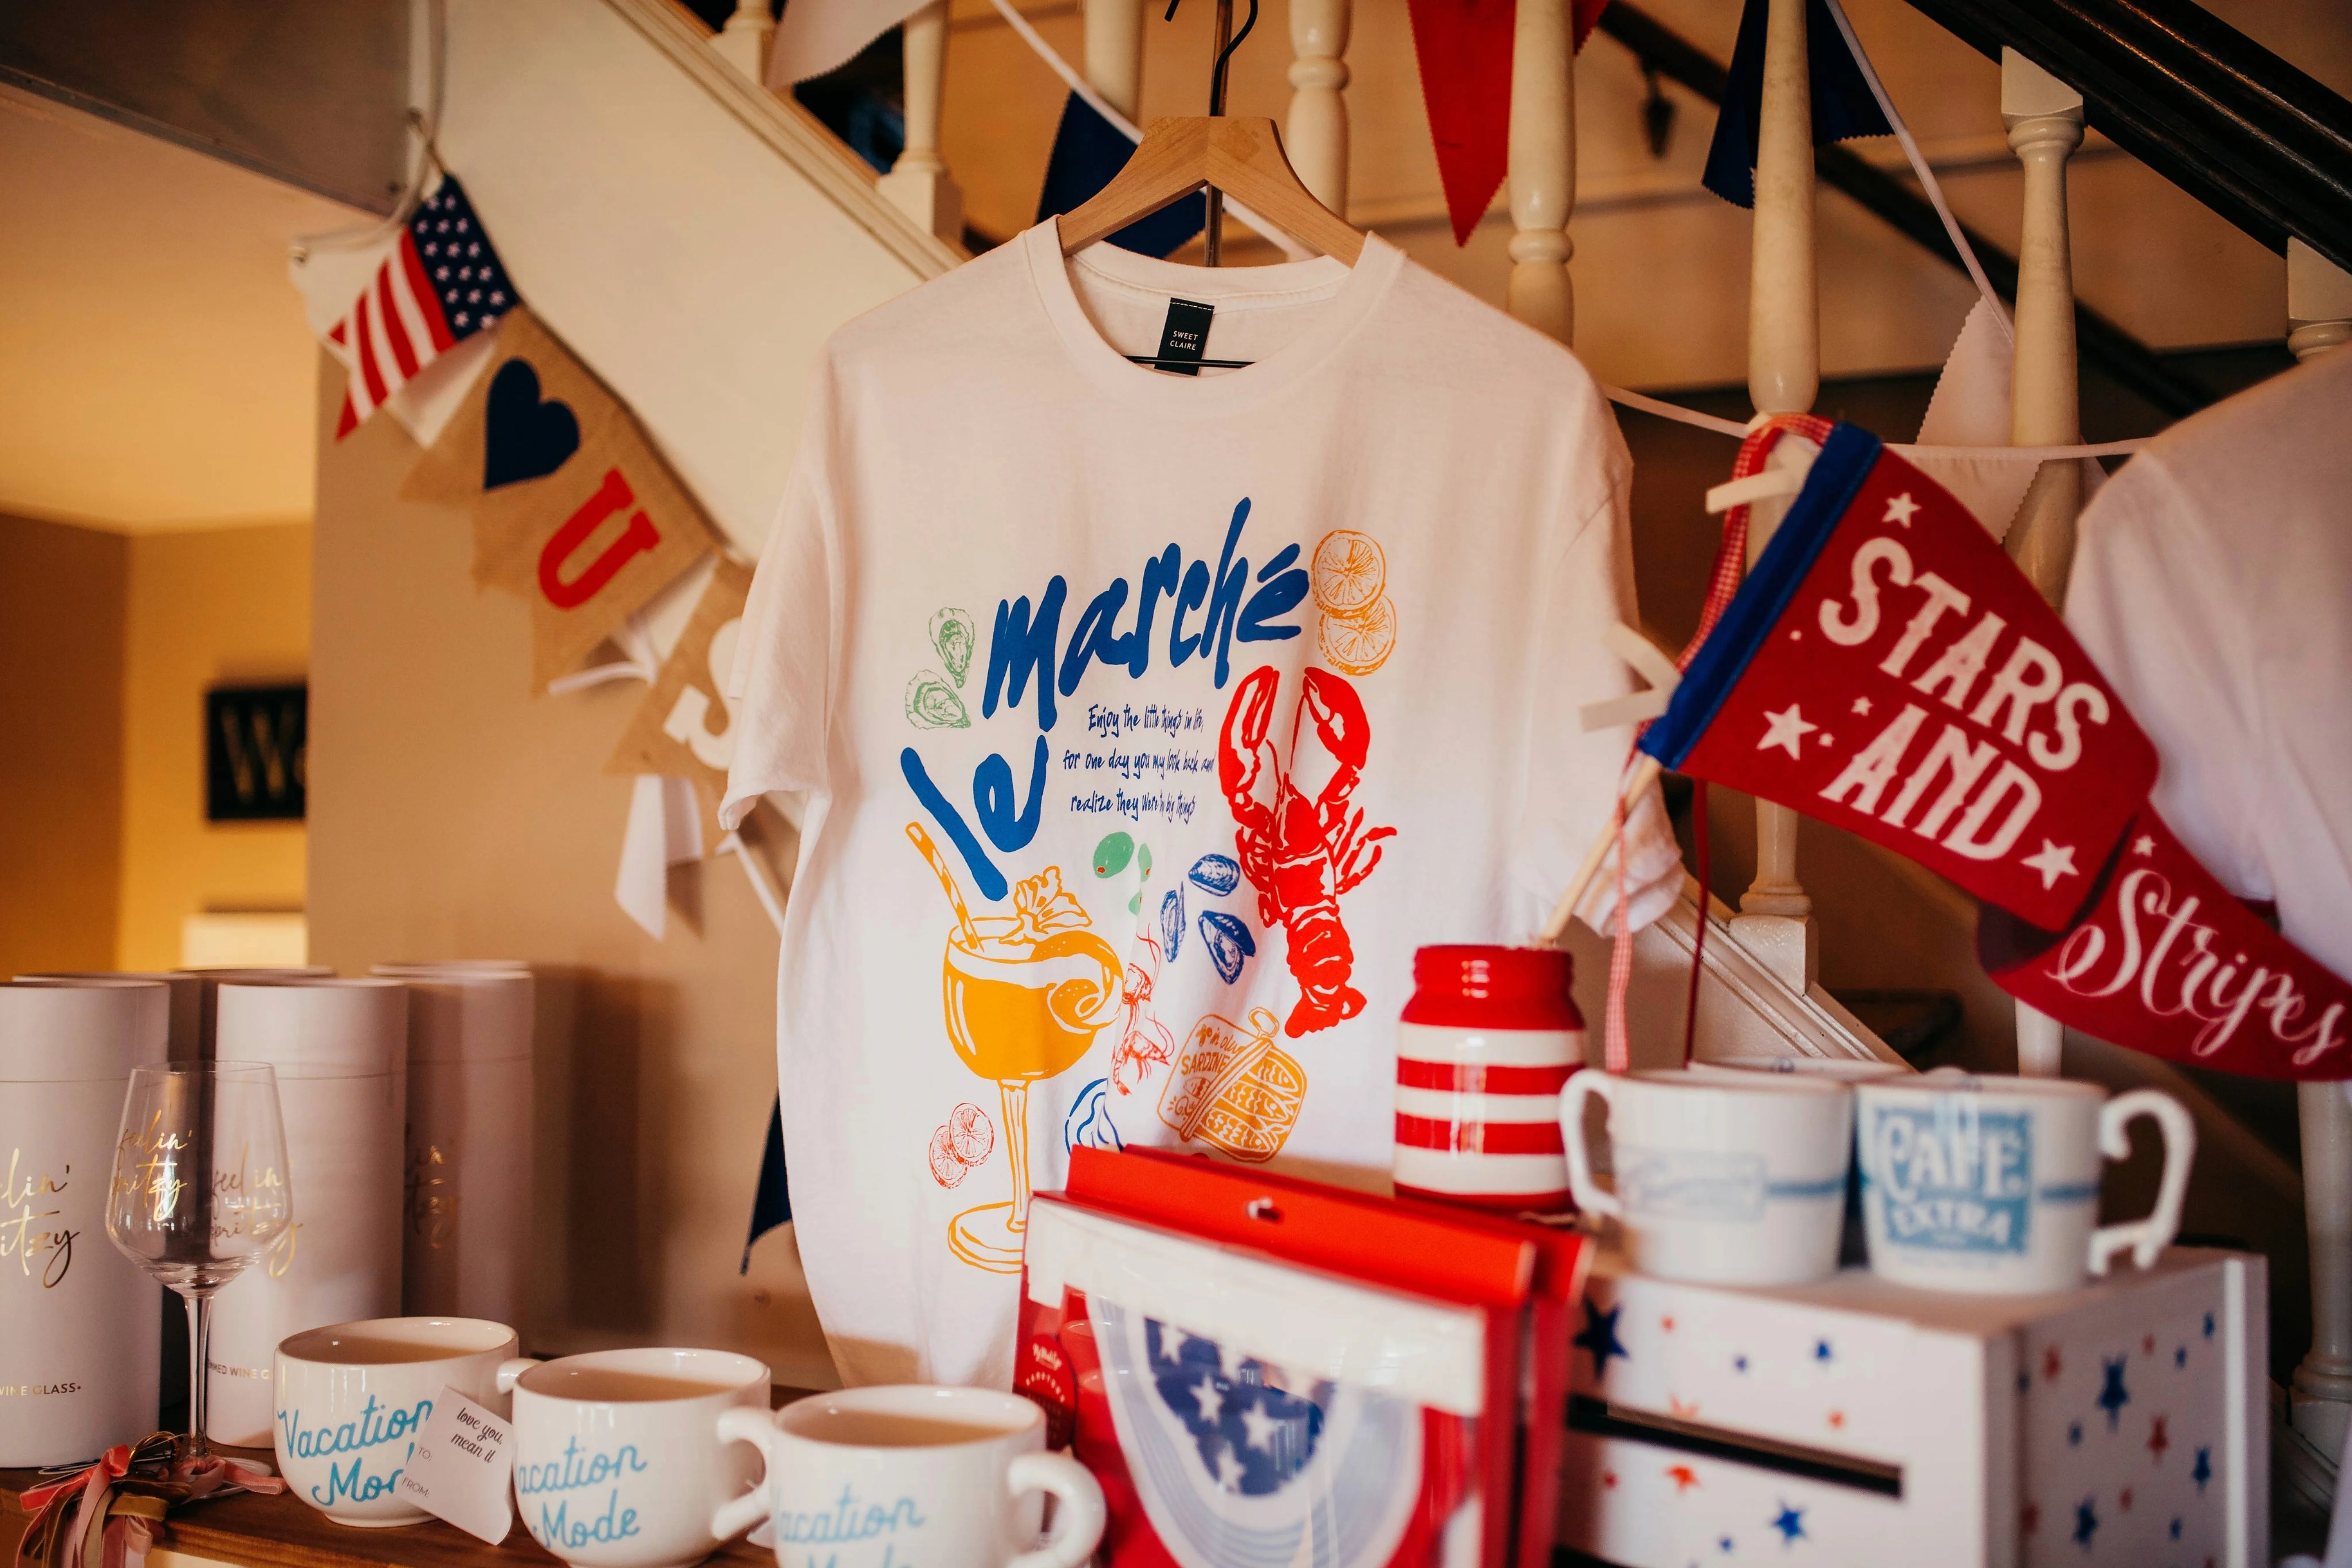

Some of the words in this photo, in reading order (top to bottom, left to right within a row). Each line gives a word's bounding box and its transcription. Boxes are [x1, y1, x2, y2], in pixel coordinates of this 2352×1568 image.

[1170, 340, 1196, 350] CLAIRE
[1173, 331, 1198, 341] SWEET
[538, 467, 662, 611] U
[1818, 537, 2110, 771] STARS
[1088, 704, 1119, 737] Enjoy
[1124, 704, 1140, 731] the
[1144, 704, 1159, 729] little
[1161, 705, 1183, 738] things
[1184, 711, 1192, 730] in
[1063, 750, 1080, 770] for
[1085, 753, 1105, 770] one
[1108, 748, 1129, 779] day
[1133, 753, 1150, 779] you
[1166, 748, 1180, 773] look
[1183, 750, 1198, 774] back
[1201, 751, 1217, 773] and
[1818, 703, 2042, 861] AND
[901, 735, 1049, 902] le
[1071, 791, 1113, 813] realize
[1116, 788, 1139, 821] they
[1166, 793, 1175, 823] big
[1176, 791, 1197, 825] things
[2043, 868, 2346, 1066] Stripes
[0, 1148, 70, 1208] lin'
[111, 1154, 188, 1221] pritzy
[229, 1366, 258, 1379] WINE
[277, 1394, 433, 1459] Vacation
[418, 1446, 433, 1461] TO:
[450, 1433, 483, 1458] mean
[484, 1449, 496, 1463] it
[456, 1407, 480, 1430] love
[476, 1424, 503, 1445] you,
[311, 1442, 415, 1506] Mo
[401, 1476, 430, 1498] FROM:
[517, 1435, 647, 1495] acation
[532, 1489, 641, 1549] Mode
[779, 1482, 927, 1544] acation
